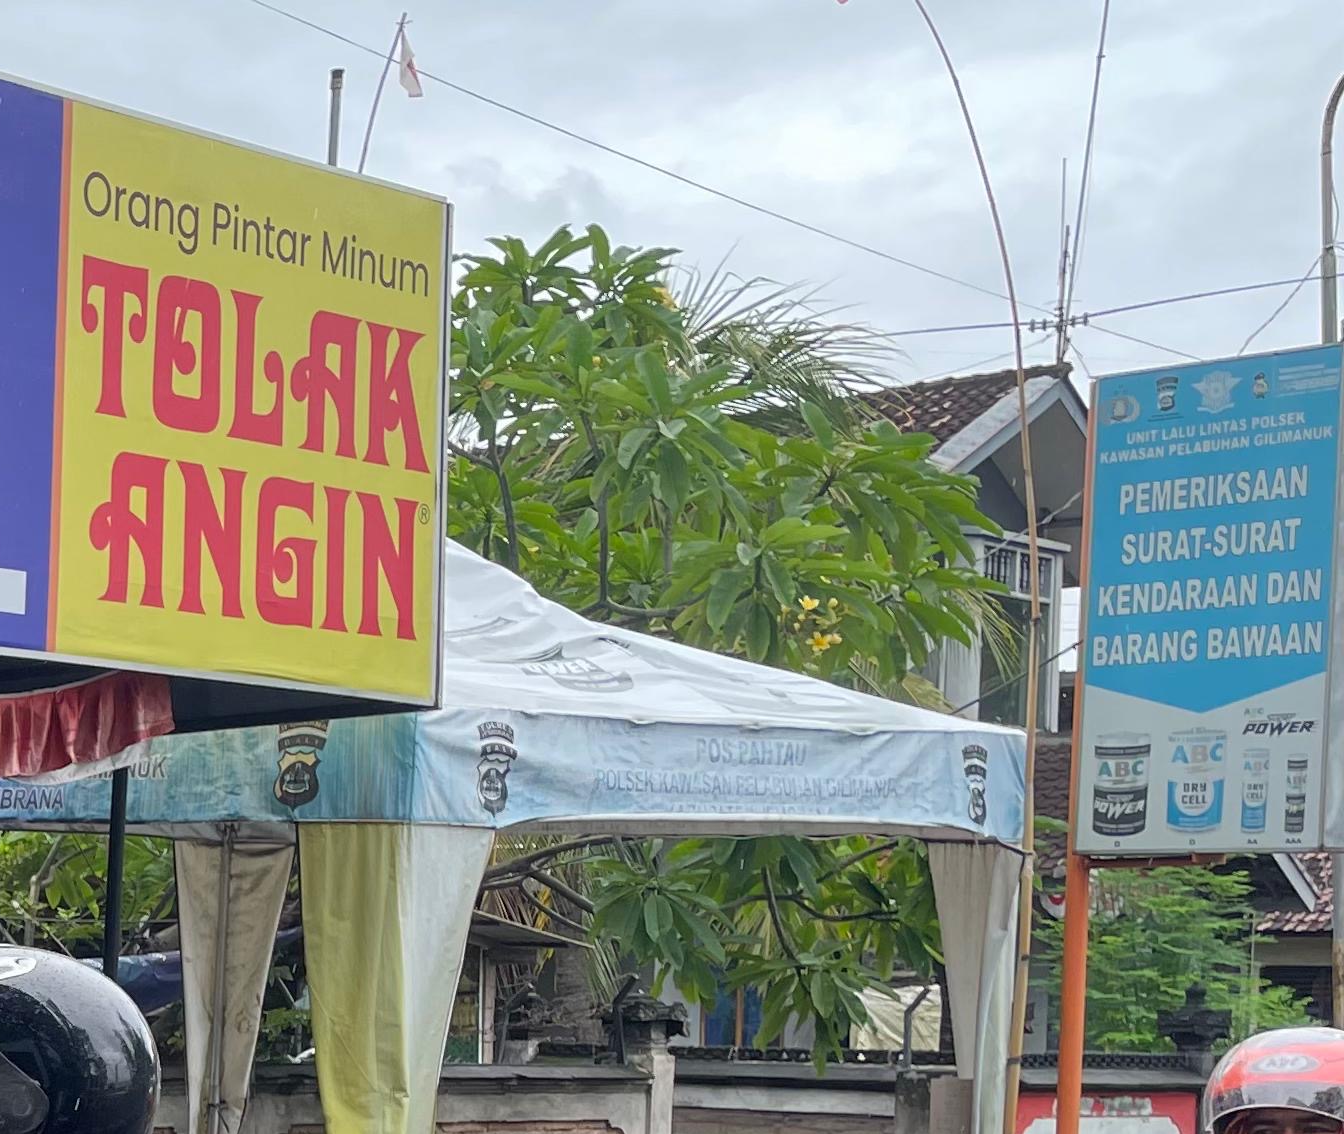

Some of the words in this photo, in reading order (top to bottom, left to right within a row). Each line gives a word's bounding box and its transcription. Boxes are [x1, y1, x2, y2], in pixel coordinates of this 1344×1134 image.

[81, 170, 201, 256] Orang
[211, 202, 312, 269] Pintar
[321, 230, 431, 299] Minum
[80, 253, 432, 474] TOLAK
[1099, 446, 1165, 465] KAWASAN
[1168, 435, 1250, 457] PELABUHAN
[1254, 425, 1334, 447] GILIMANUK
[1126, 428, 1160, 446] UNIT
[1161, 424, 1196, 442] LALU
[1199, 417, 1247, 437] LINTAS
[1251, 411, 1306, 430] POLSEK
[1119, 464, 1309, 516] PEMERIKSAAN
[88, 450, 421, 642] ANGIN
[1121, 517, 1302, 566] SURAT-SURAT
[1097, 573, 1258, 617] KENDARAAN
[1266, 567, 1322, 605] DAN
[1092, 629, 1198, 667] BARANG
[1206, 620, 1323, 661] BAWAAN
[1242, 720, 1315, 737] POWER
[1098, 759, 1145, 777] ABC
[1171, 743, 1224, 764] ABC
[1181, 794, 1208, 805] CELL
[1183, 782, 1207, 793] DRY
[1093, 799, 1145, 820] POWER
